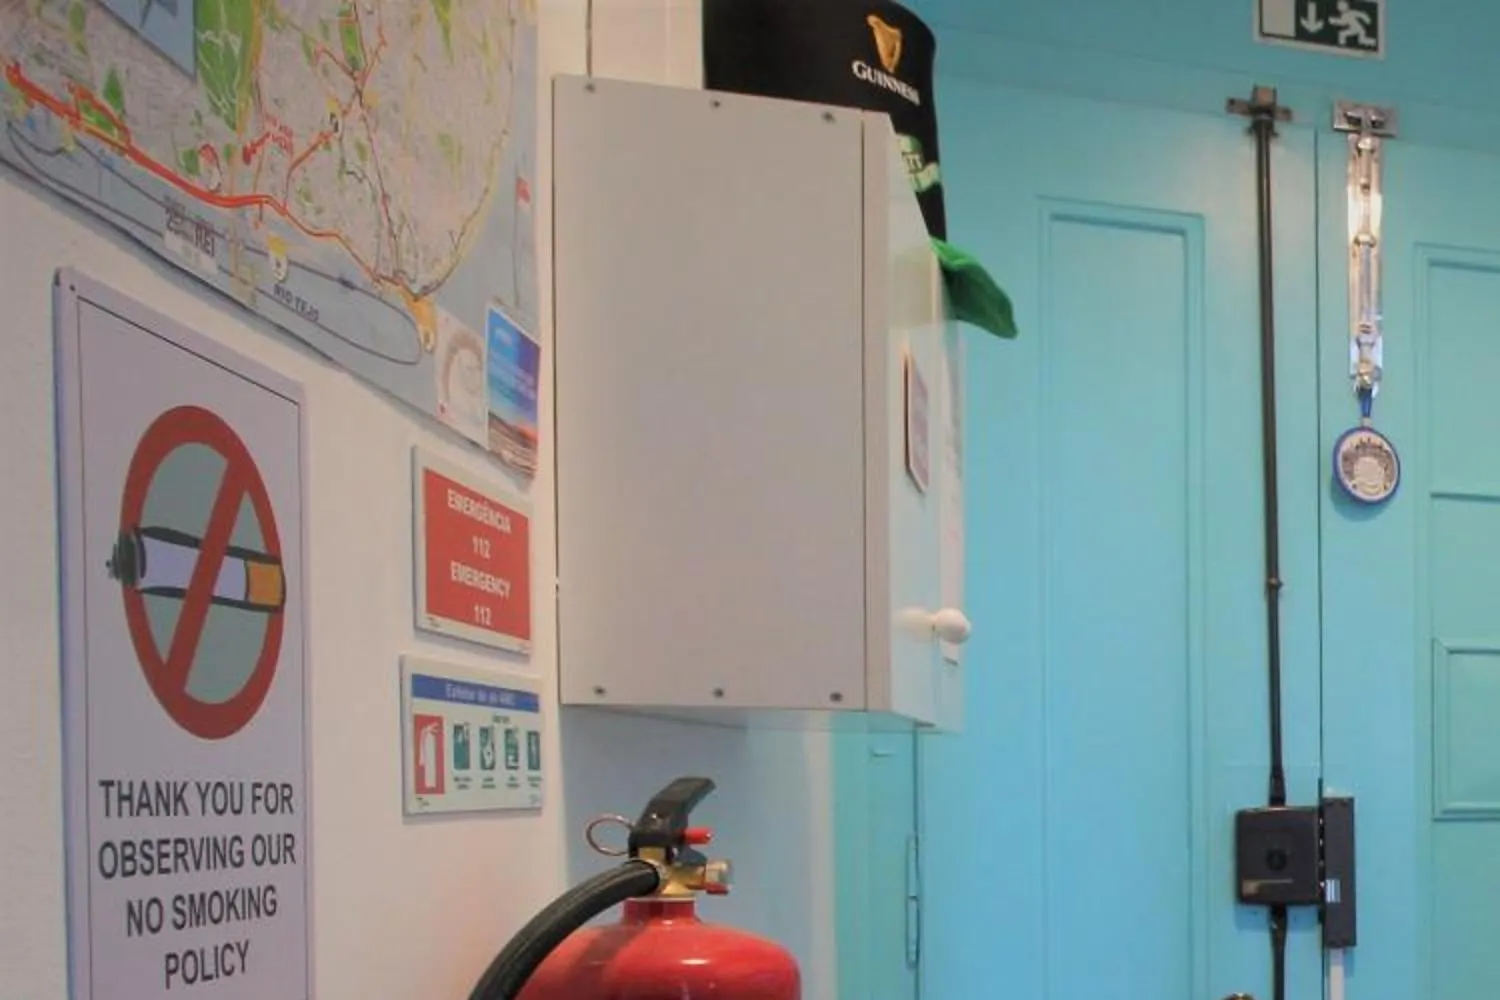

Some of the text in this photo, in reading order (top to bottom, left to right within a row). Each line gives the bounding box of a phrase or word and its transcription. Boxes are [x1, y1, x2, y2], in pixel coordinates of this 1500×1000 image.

[852, 60, 921, 106] GUINNESS
[472, 536, 491, 559] 112
[450, 561, 511, 599] EMERGENCY
[474, 604, 492, 626] 112
[98, 779, 296, 818] THANK YOU FOR
[98, 833, 296, 880] OBSERVING OUR
[126, 884, 278, 938] NO SMOKING
[165, 939, 250, 990] POLICY
